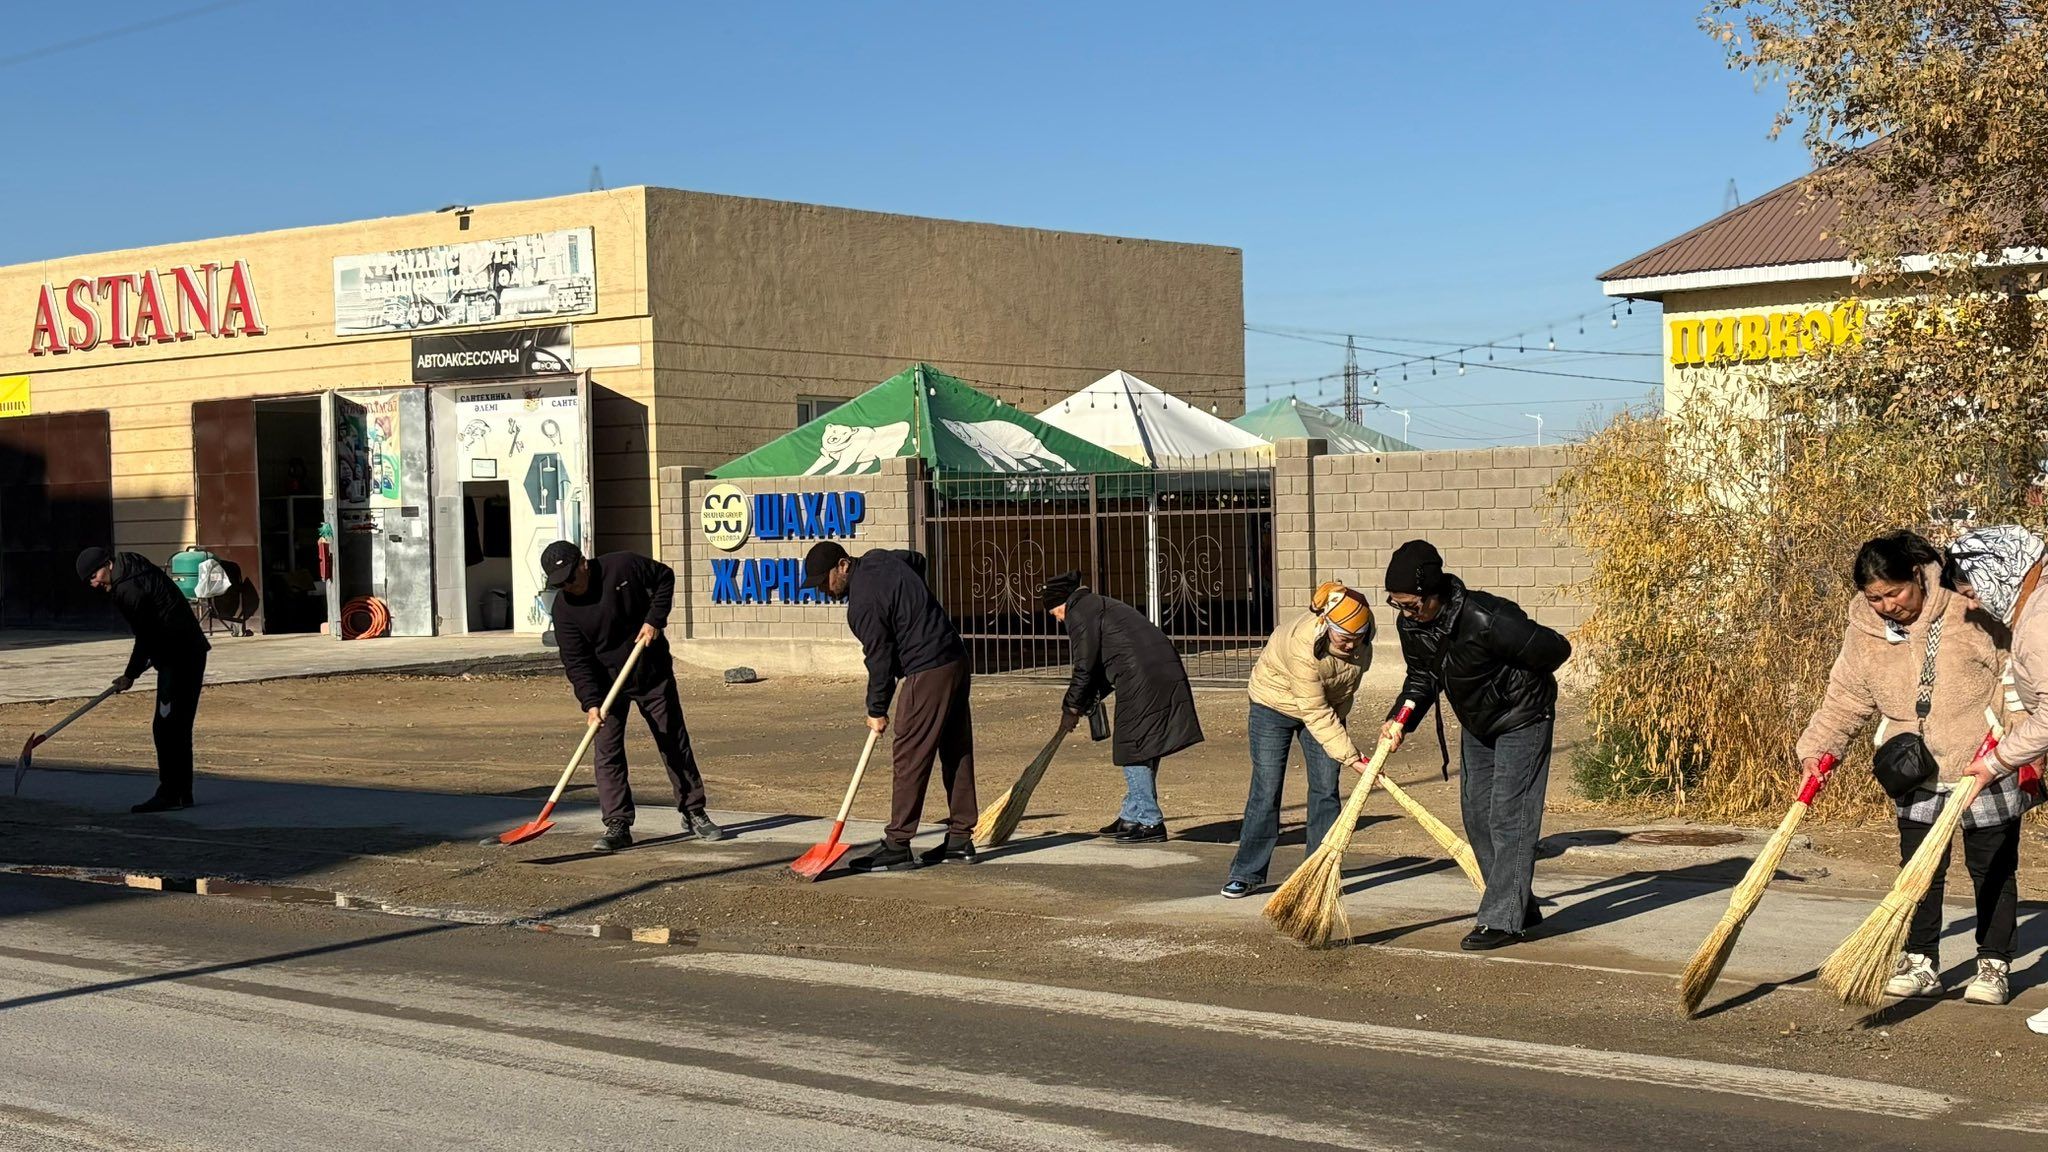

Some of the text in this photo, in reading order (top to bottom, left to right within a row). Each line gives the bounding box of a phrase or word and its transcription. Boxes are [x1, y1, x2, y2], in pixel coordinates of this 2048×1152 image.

[28, 258, 268, 356] ASTANA
[416, 348, 520, 369] АВТОАКСЕССУАРЫ
[460, 392, 512, 403] САНТЕХНИКА
[704, 493, 742, 534] SG
[754, 491, 866, 539] ШАХАР
